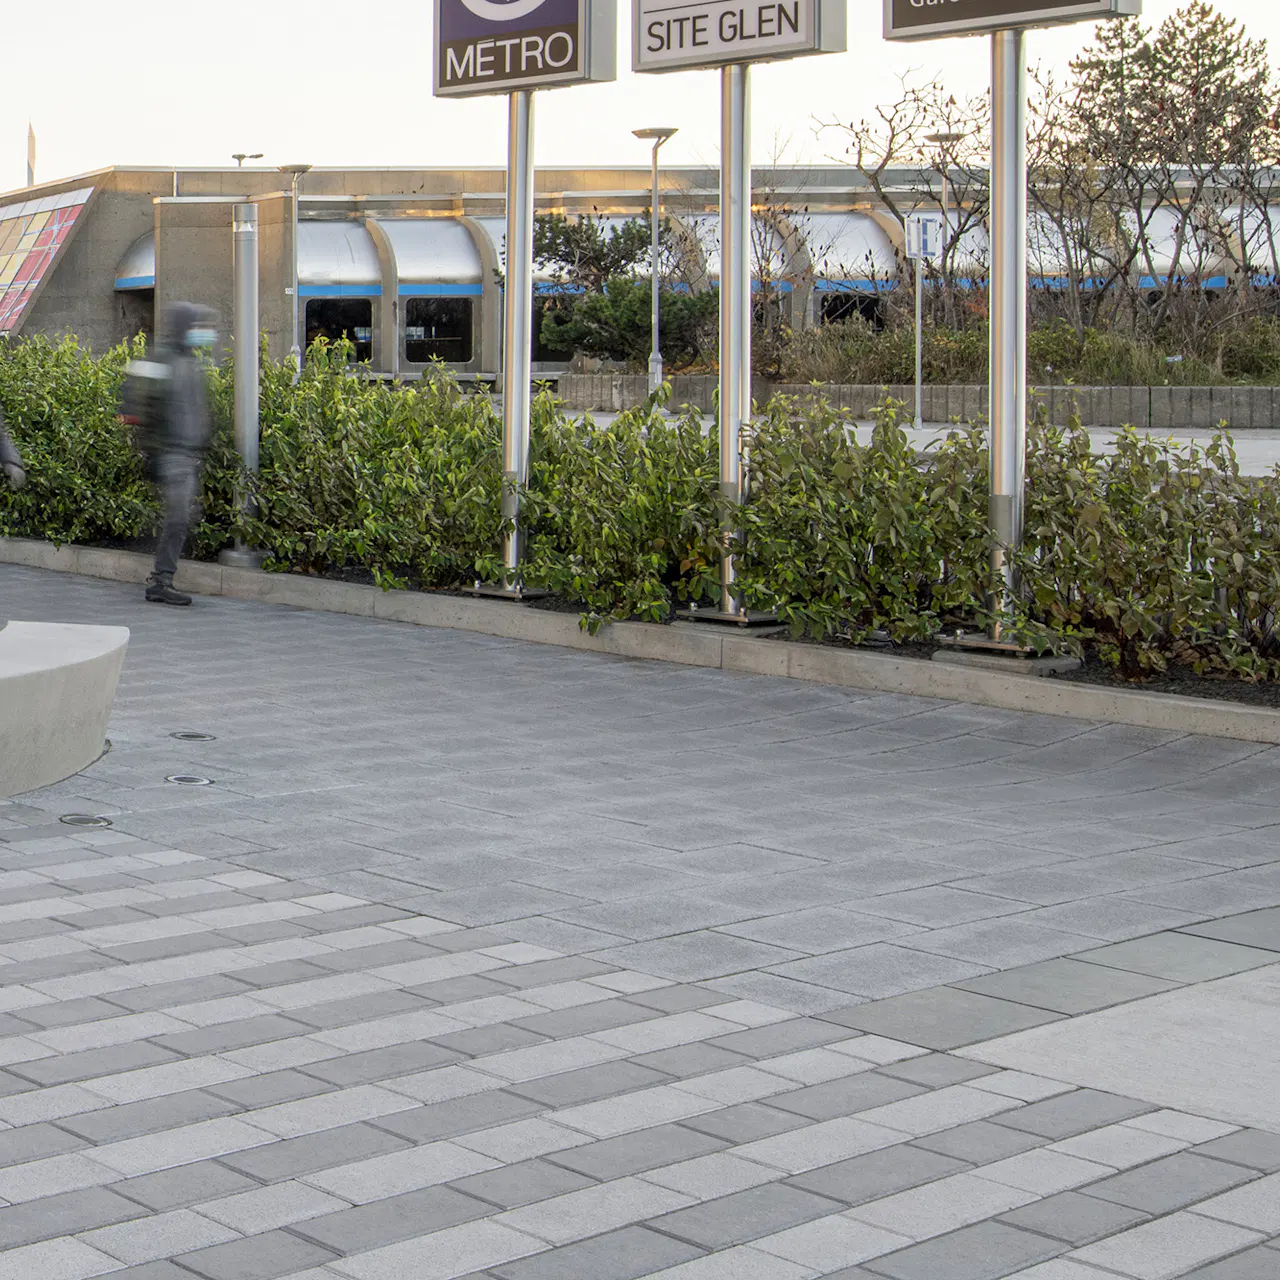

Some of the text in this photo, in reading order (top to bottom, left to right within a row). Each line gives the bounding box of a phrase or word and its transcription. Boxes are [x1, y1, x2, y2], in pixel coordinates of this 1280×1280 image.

[647, 1, 799, 53] SITE GLEN
[445, 31, 573, 81] MÉTRO
